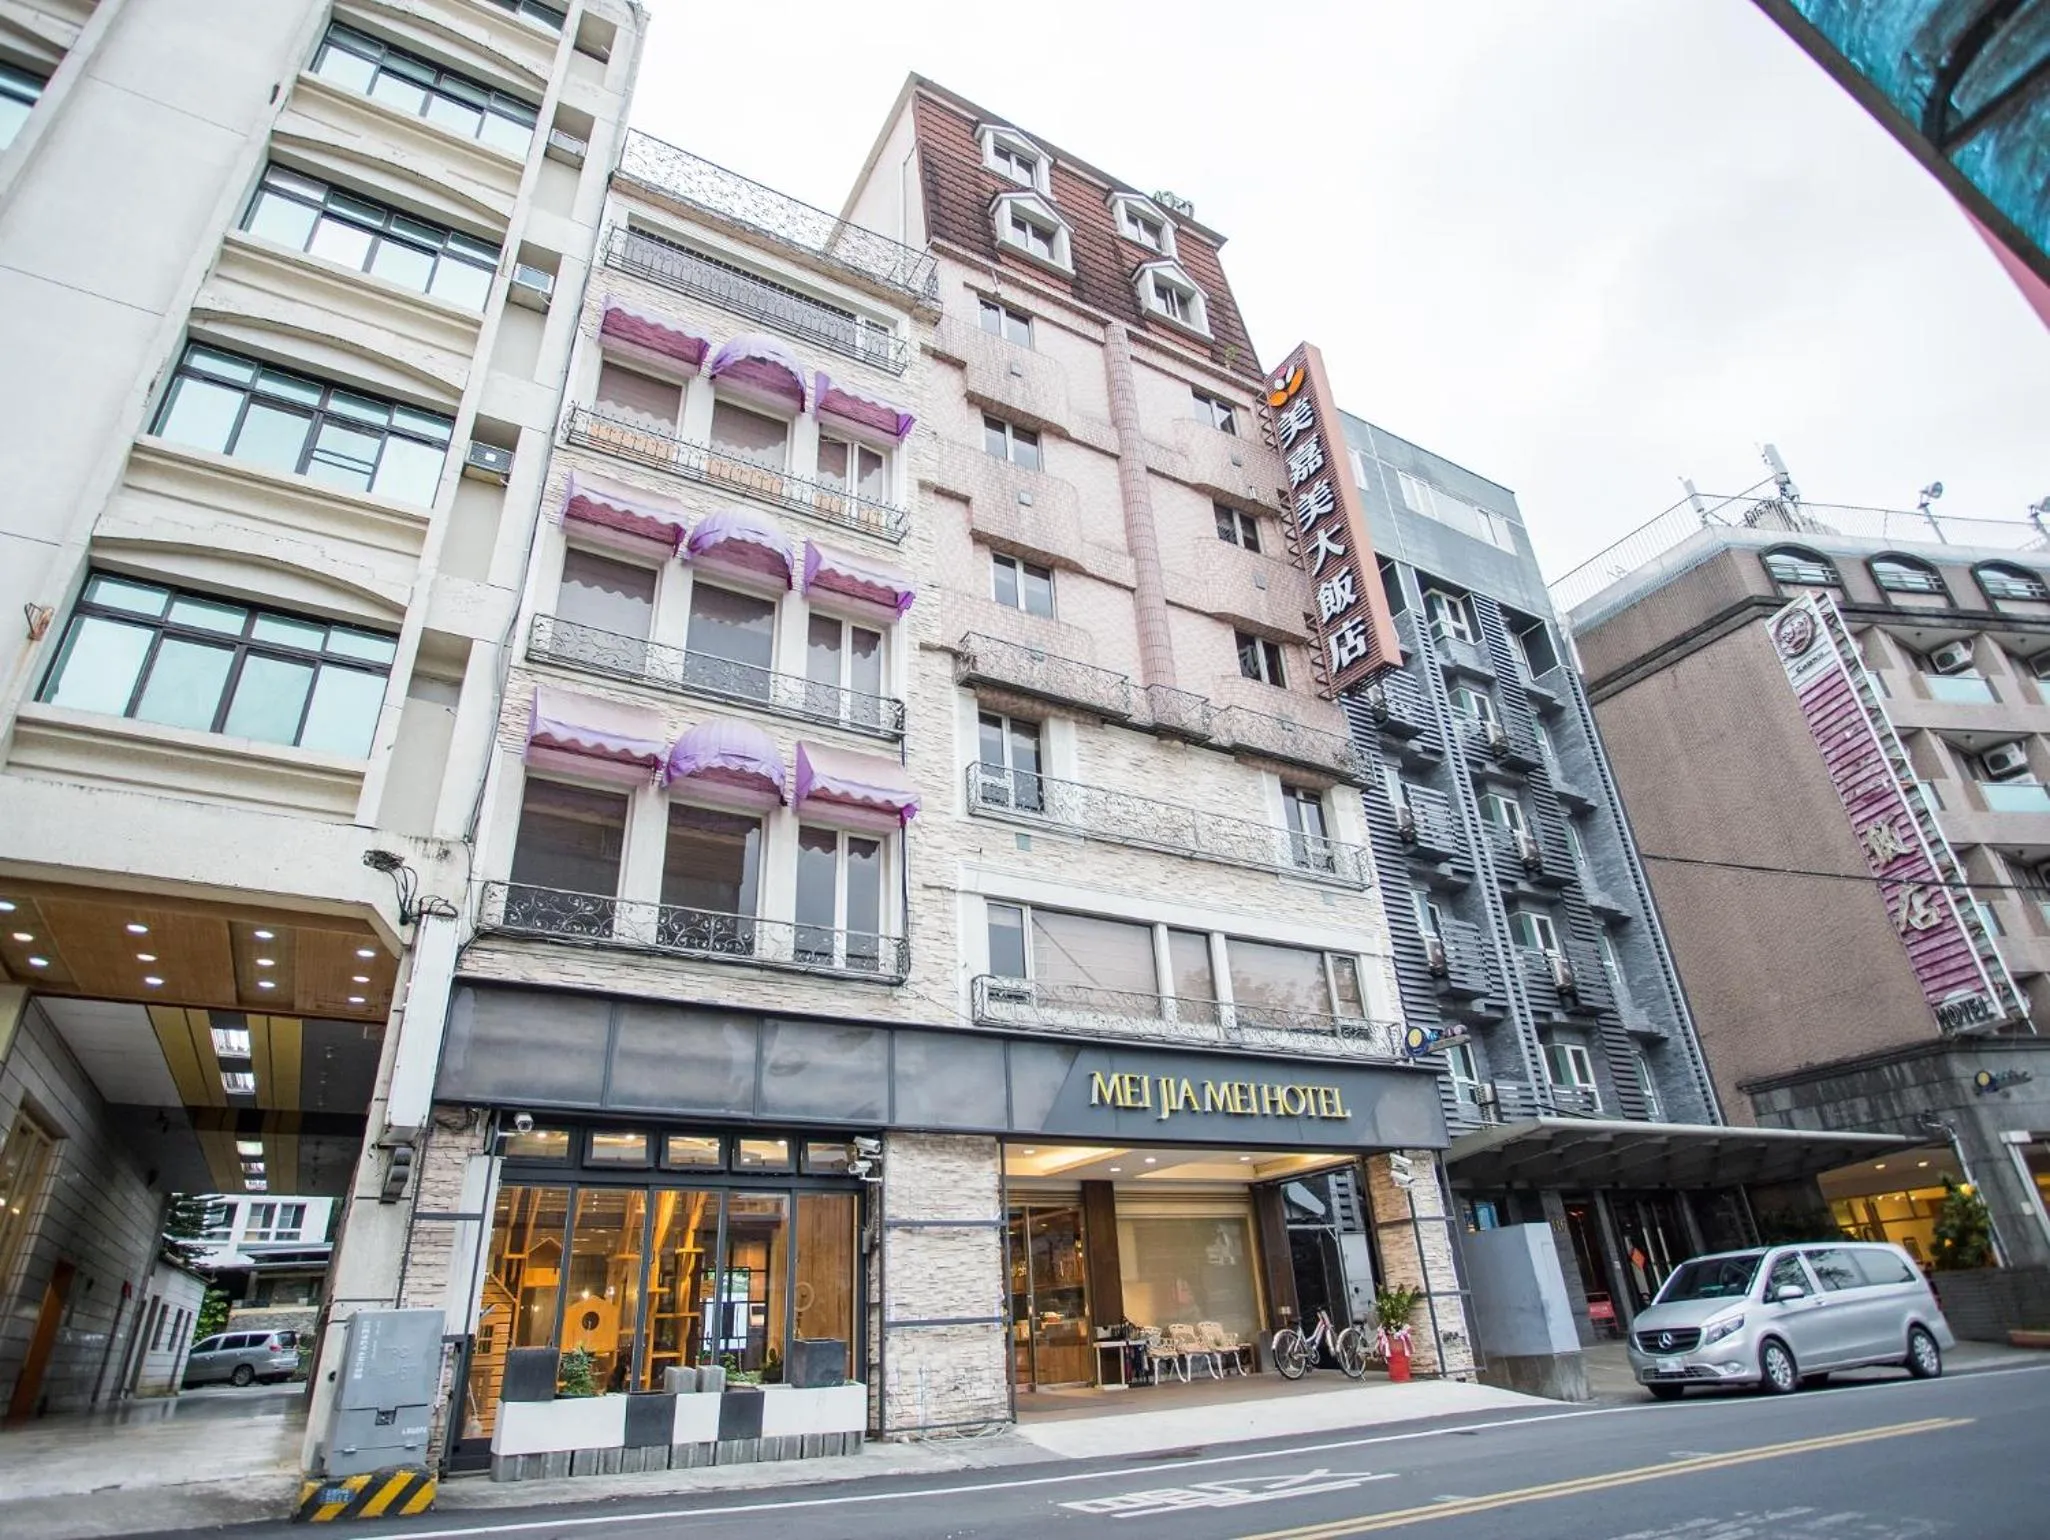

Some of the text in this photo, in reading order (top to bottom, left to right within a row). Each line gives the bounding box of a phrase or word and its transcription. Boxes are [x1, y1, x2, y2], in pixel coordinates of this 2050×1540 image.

[1277, 396, 1368, 677] 美嘉美大飯店
[1089, 1071, 1352, 1120] MEI JIA MEI HOTEL
